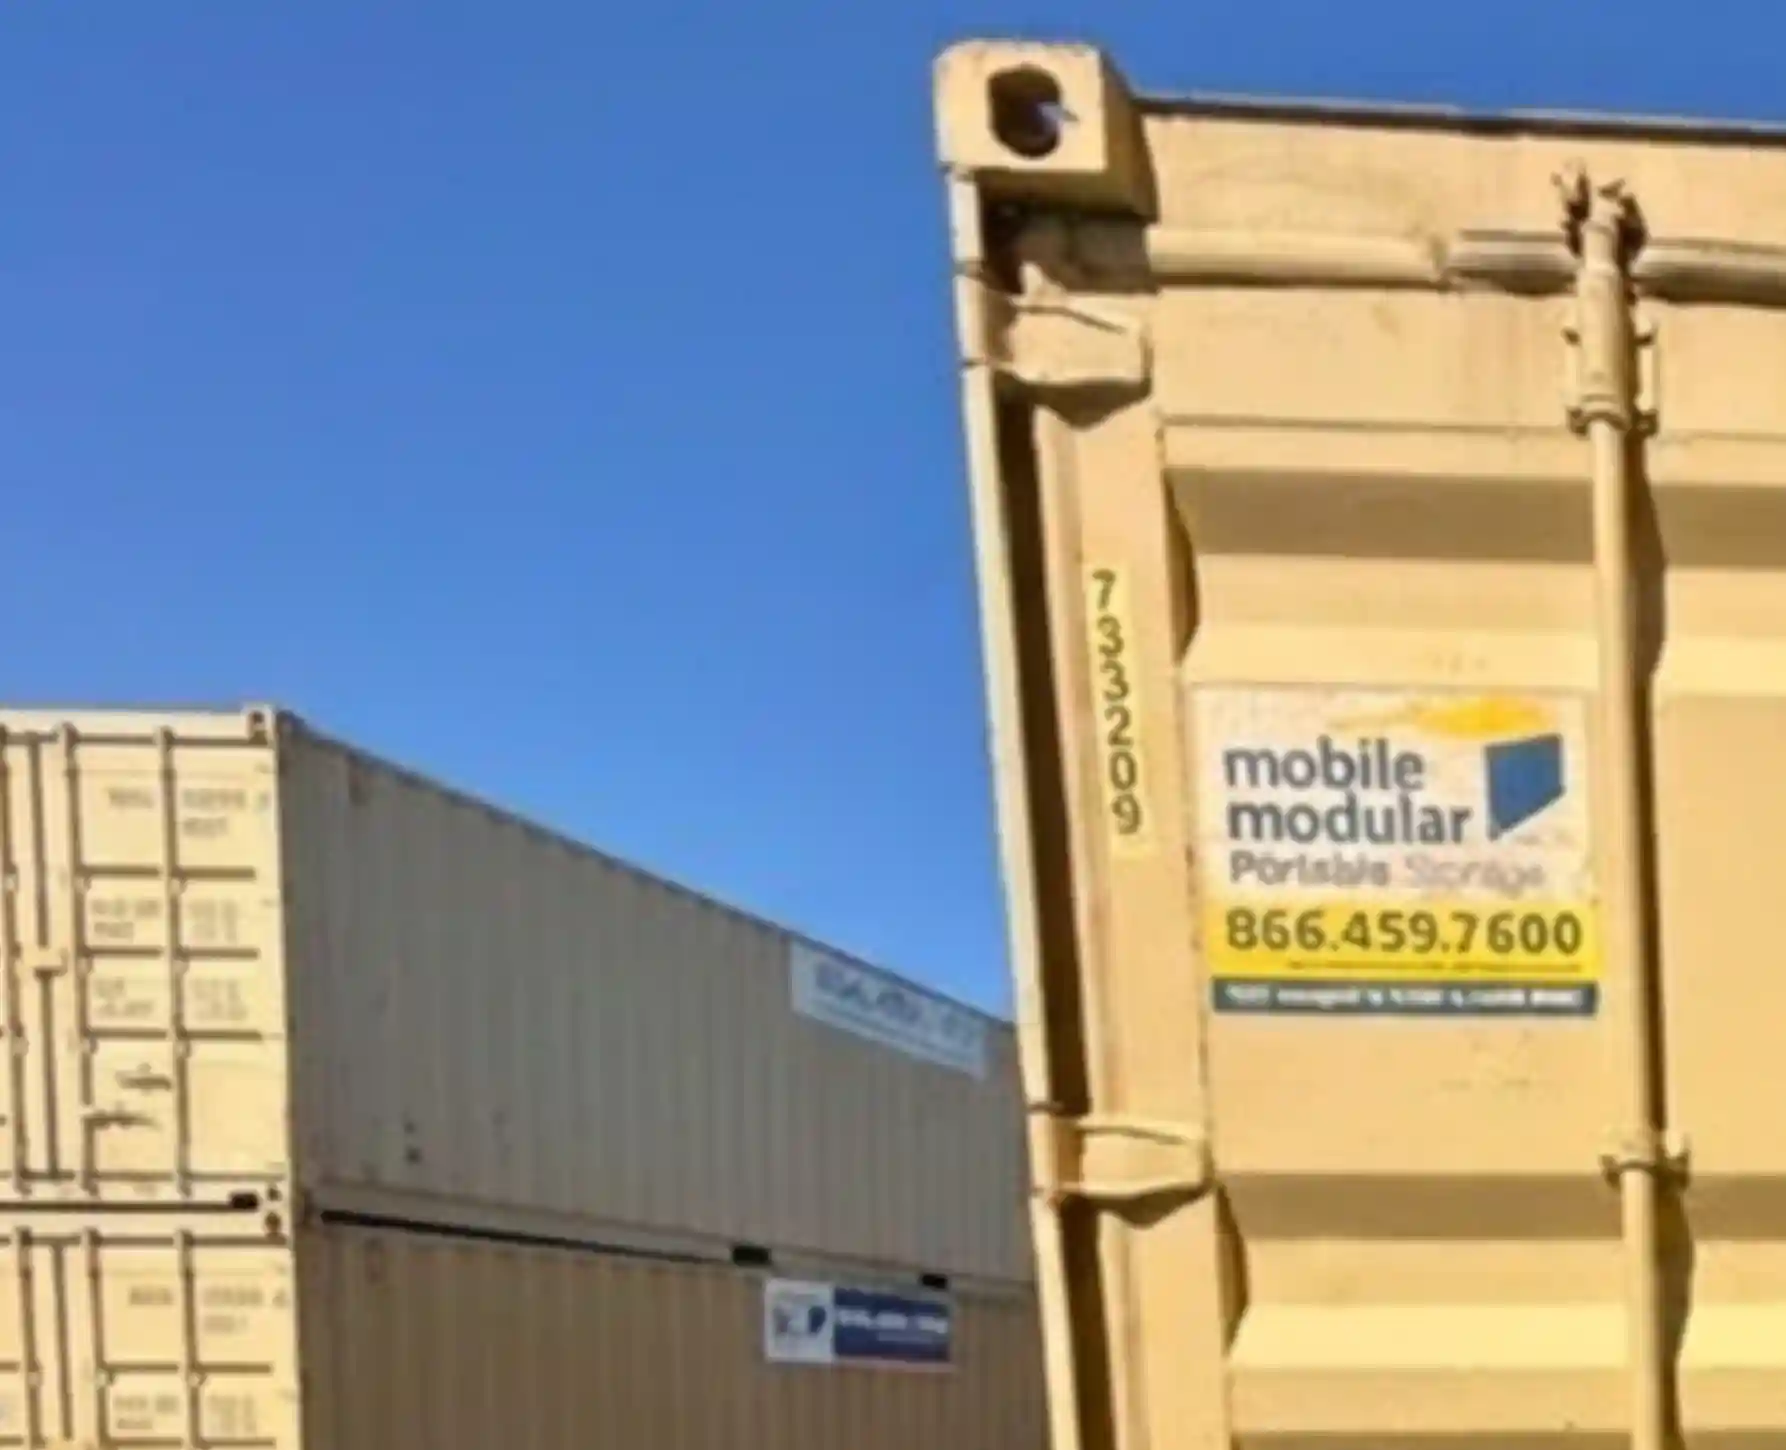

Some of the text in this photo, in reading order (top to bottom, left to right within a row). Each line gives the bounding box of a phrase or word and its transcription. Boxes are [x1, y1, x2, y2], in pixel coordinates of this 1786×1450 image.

[1091, 567, 1142, 836] 733209
[1223, 734, 1425, 790] mobile
[1226, 793, 1472, 845] modular
[1226, 907, 1583, 956] 866.459.7600
